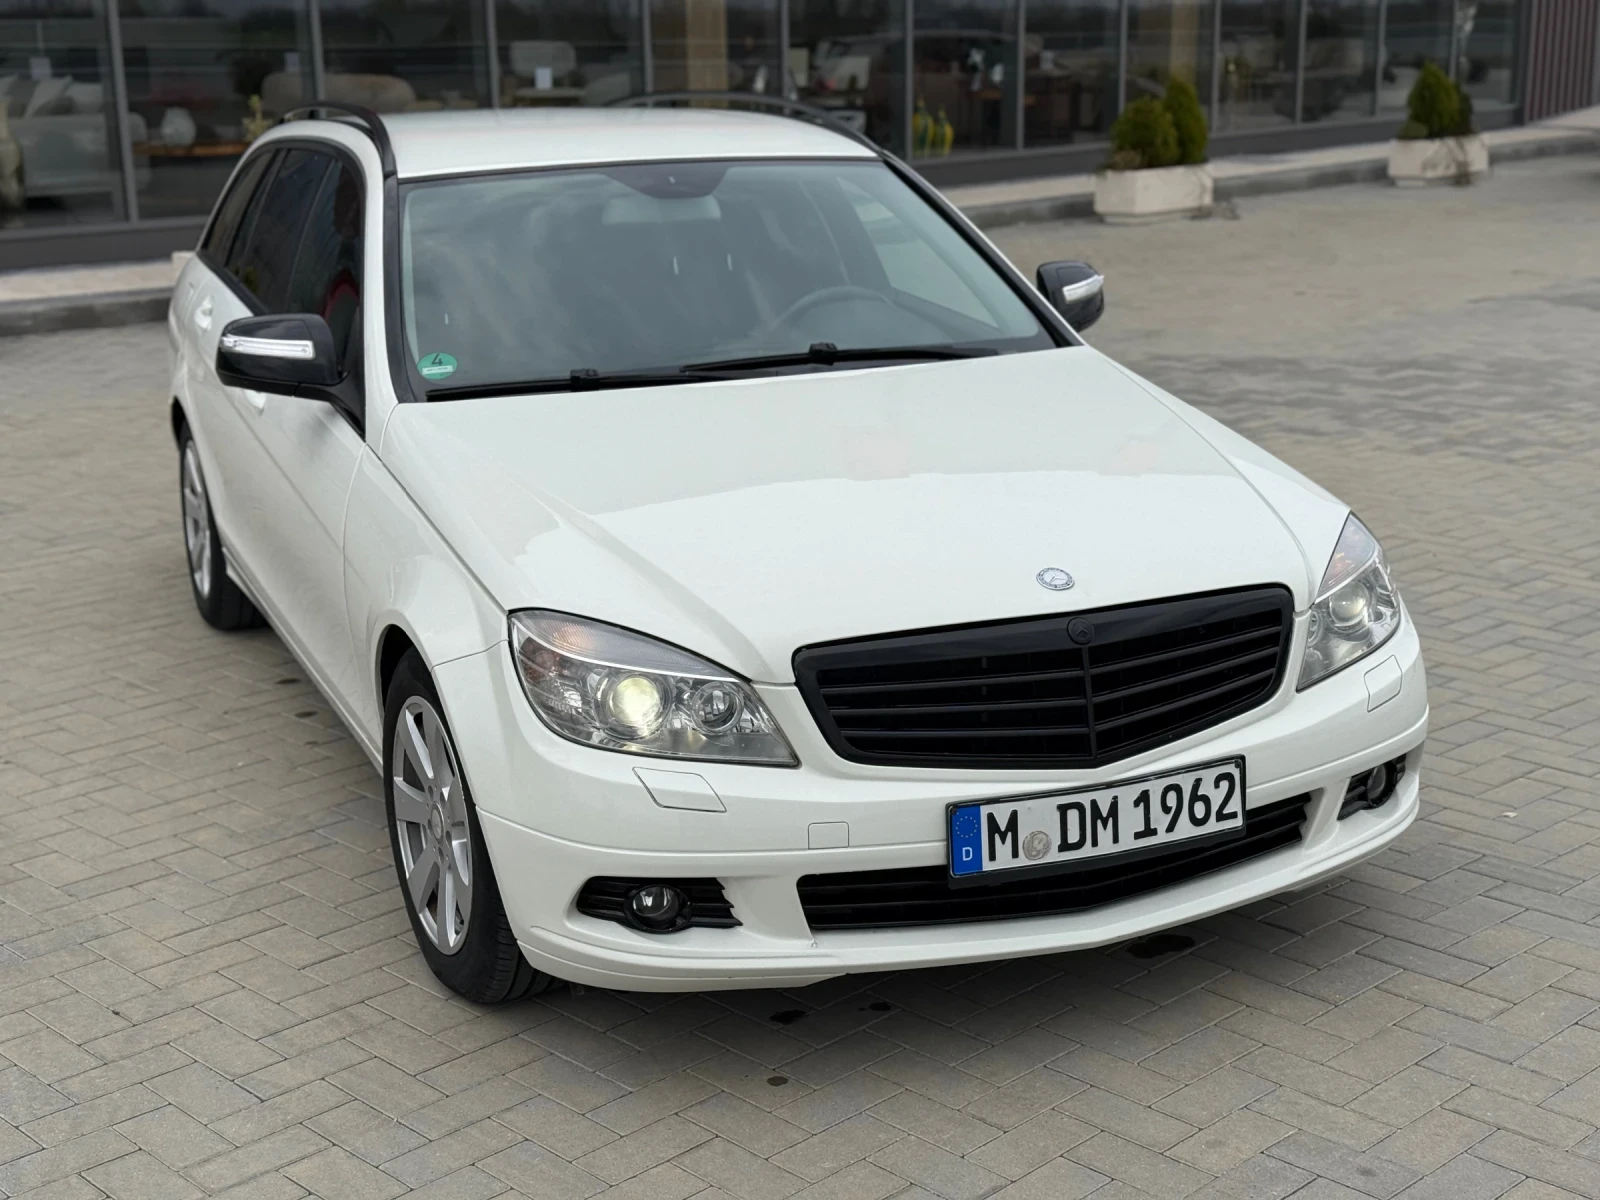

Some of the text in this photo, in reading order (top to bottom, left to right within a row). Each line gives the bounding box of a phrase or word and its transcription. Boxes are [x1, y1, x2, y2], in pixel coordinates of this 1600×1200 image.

[431, 353, 443, 366] 4
[986, 771, 1239, 862] M DM 1962
[962, 846, 973, 861] D
